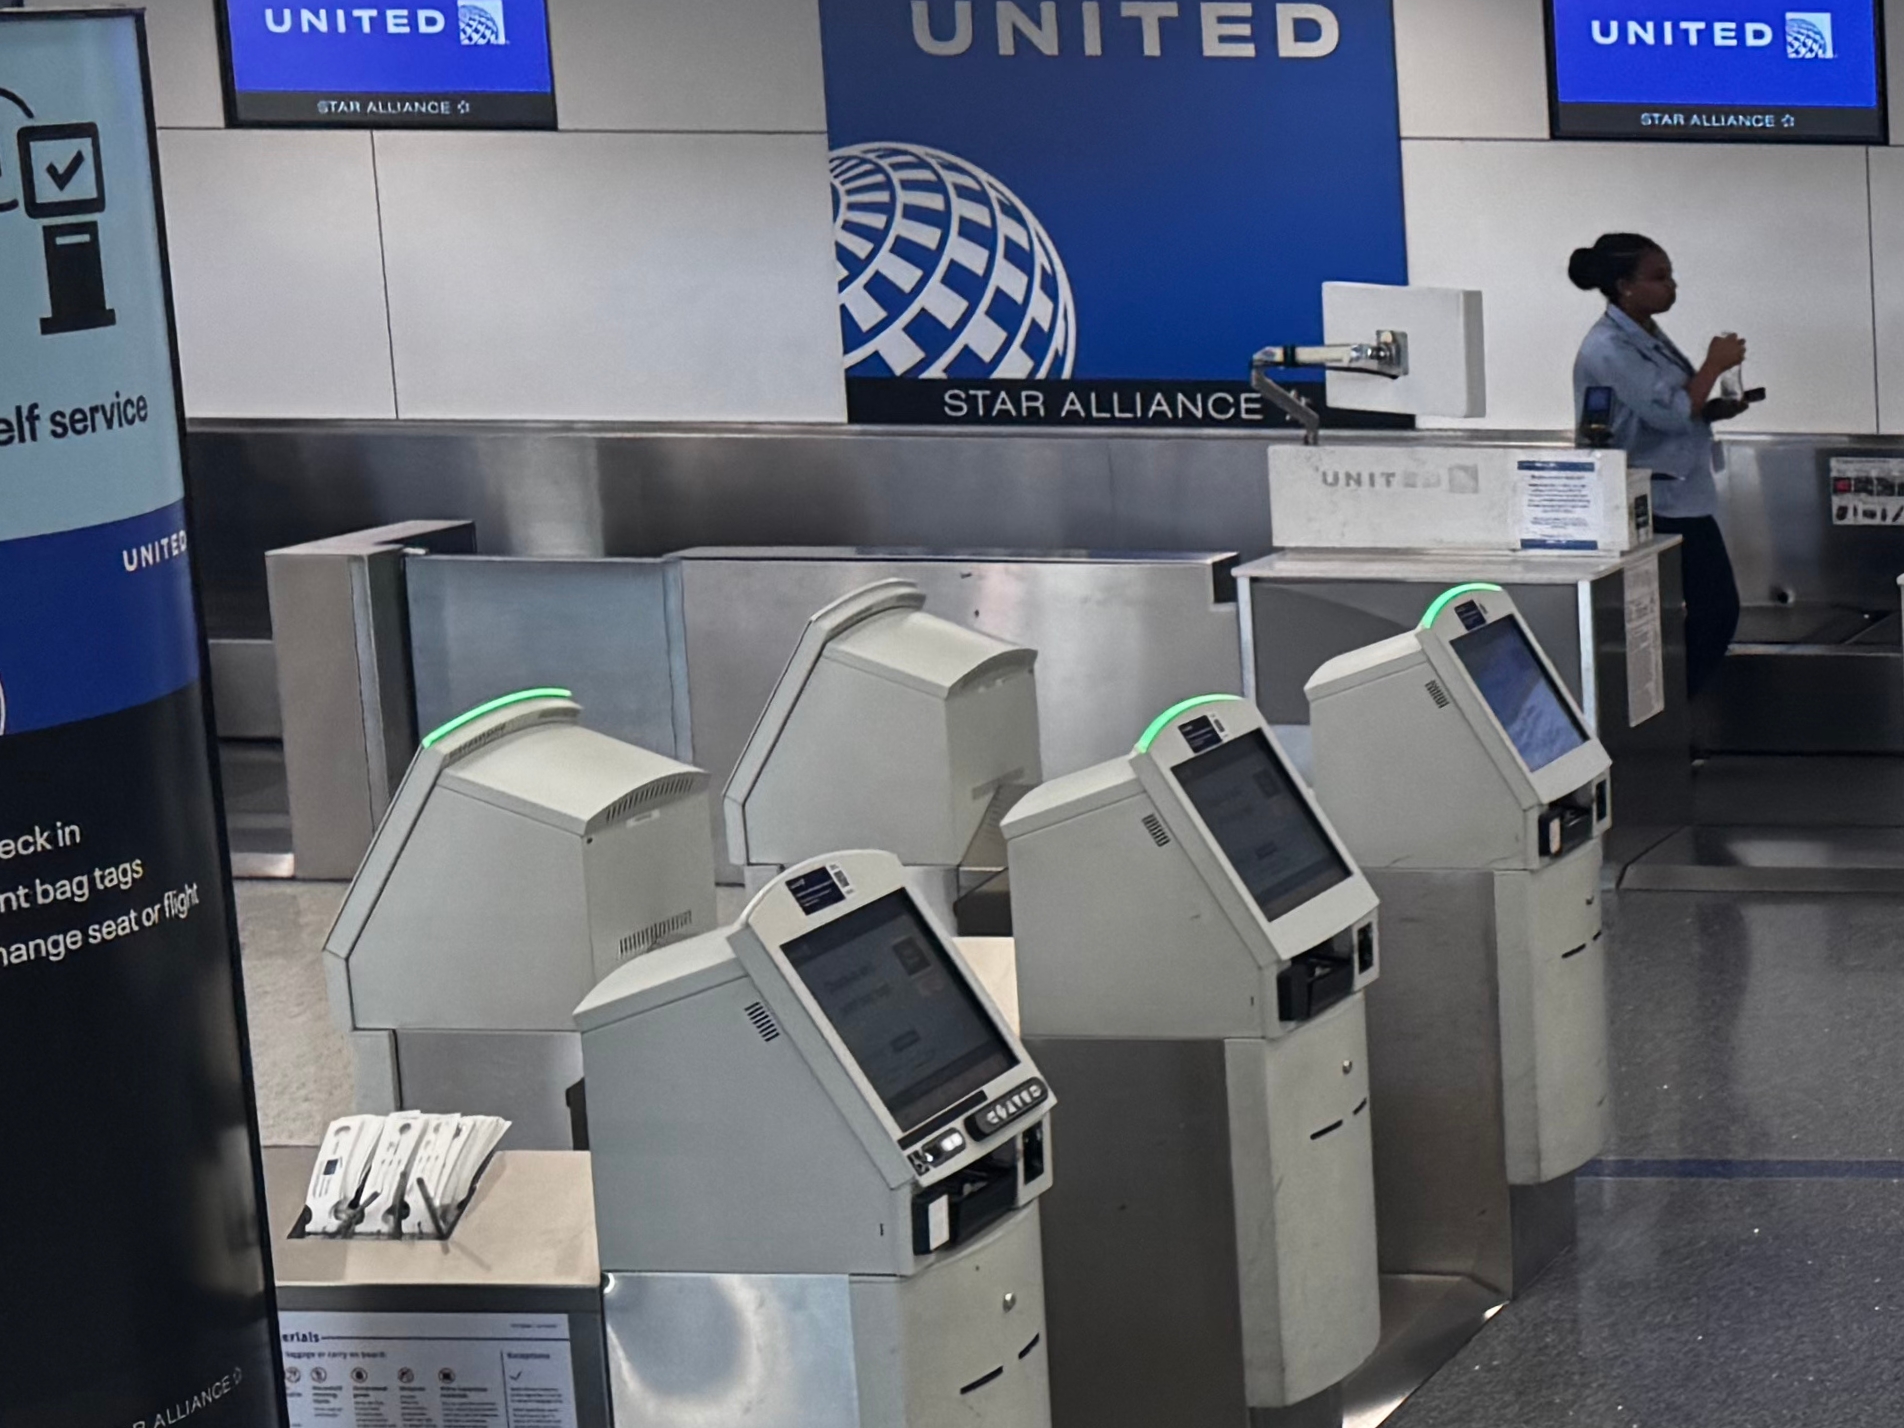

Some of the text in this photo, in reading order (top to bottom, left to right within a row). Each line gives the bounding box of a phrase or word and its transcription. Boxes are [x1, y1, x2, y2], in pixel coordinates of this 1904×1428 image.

[265, 7, 446, 35] UNITED
[1591, 19, 1774, 48] UNITED
[318, 100, 451, 114] STAR ALLIANCE
[1641, 112, 1775, 129] STAR ALLIANCE
[50, 390, 148, 439] service
[944, 388, 1262, 420] STAR ALLIANCE
[122, 529, 187, 572] UNITED
[56, 821, 81, 848] in
[35, 874, 89, 905] bag
[93, 858, 144, 891] tags
[88, 908, 140, 945] seat
[142, 902, 162, 927] or
[163, 881, 200, 919] flight
